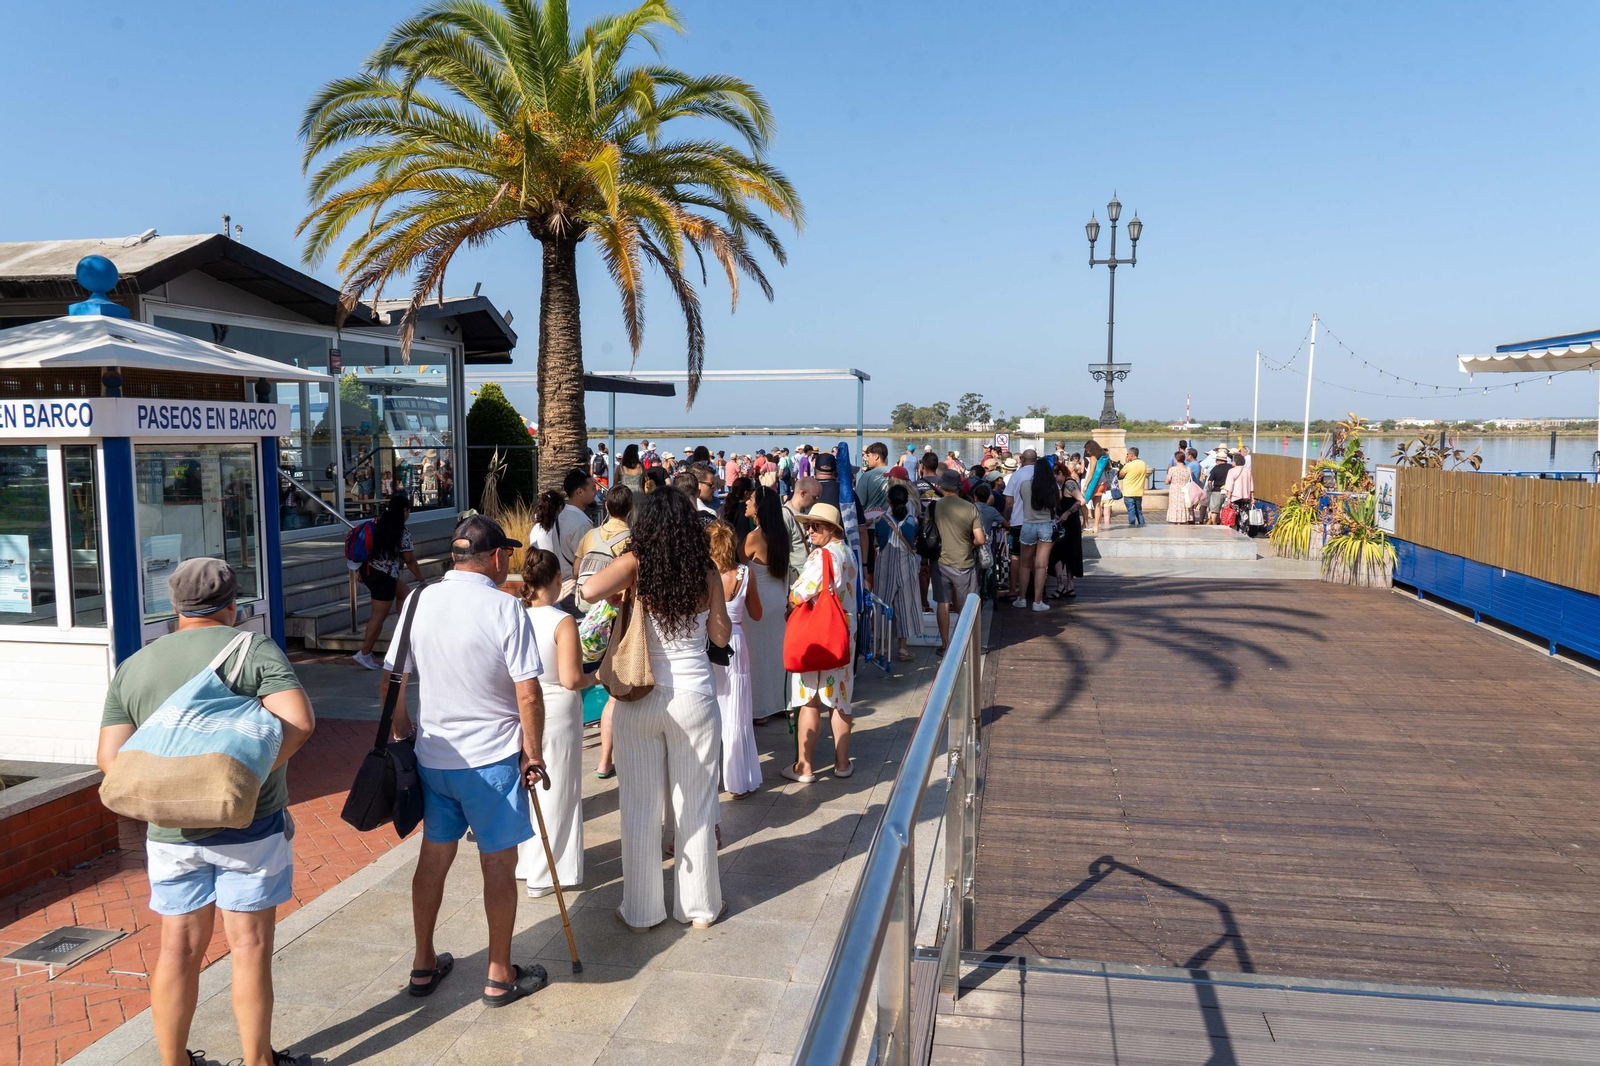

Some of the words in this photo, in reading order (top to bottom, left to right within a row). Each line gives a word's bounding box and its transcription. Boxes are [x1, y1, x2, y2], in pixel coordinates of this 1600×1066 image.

[23, 402, 94, 428] BARCO
[137, 405, 202, 430] PASEOS
[206, 407, 226, 430] EN
[229, 408, 277, 430] BARCO
